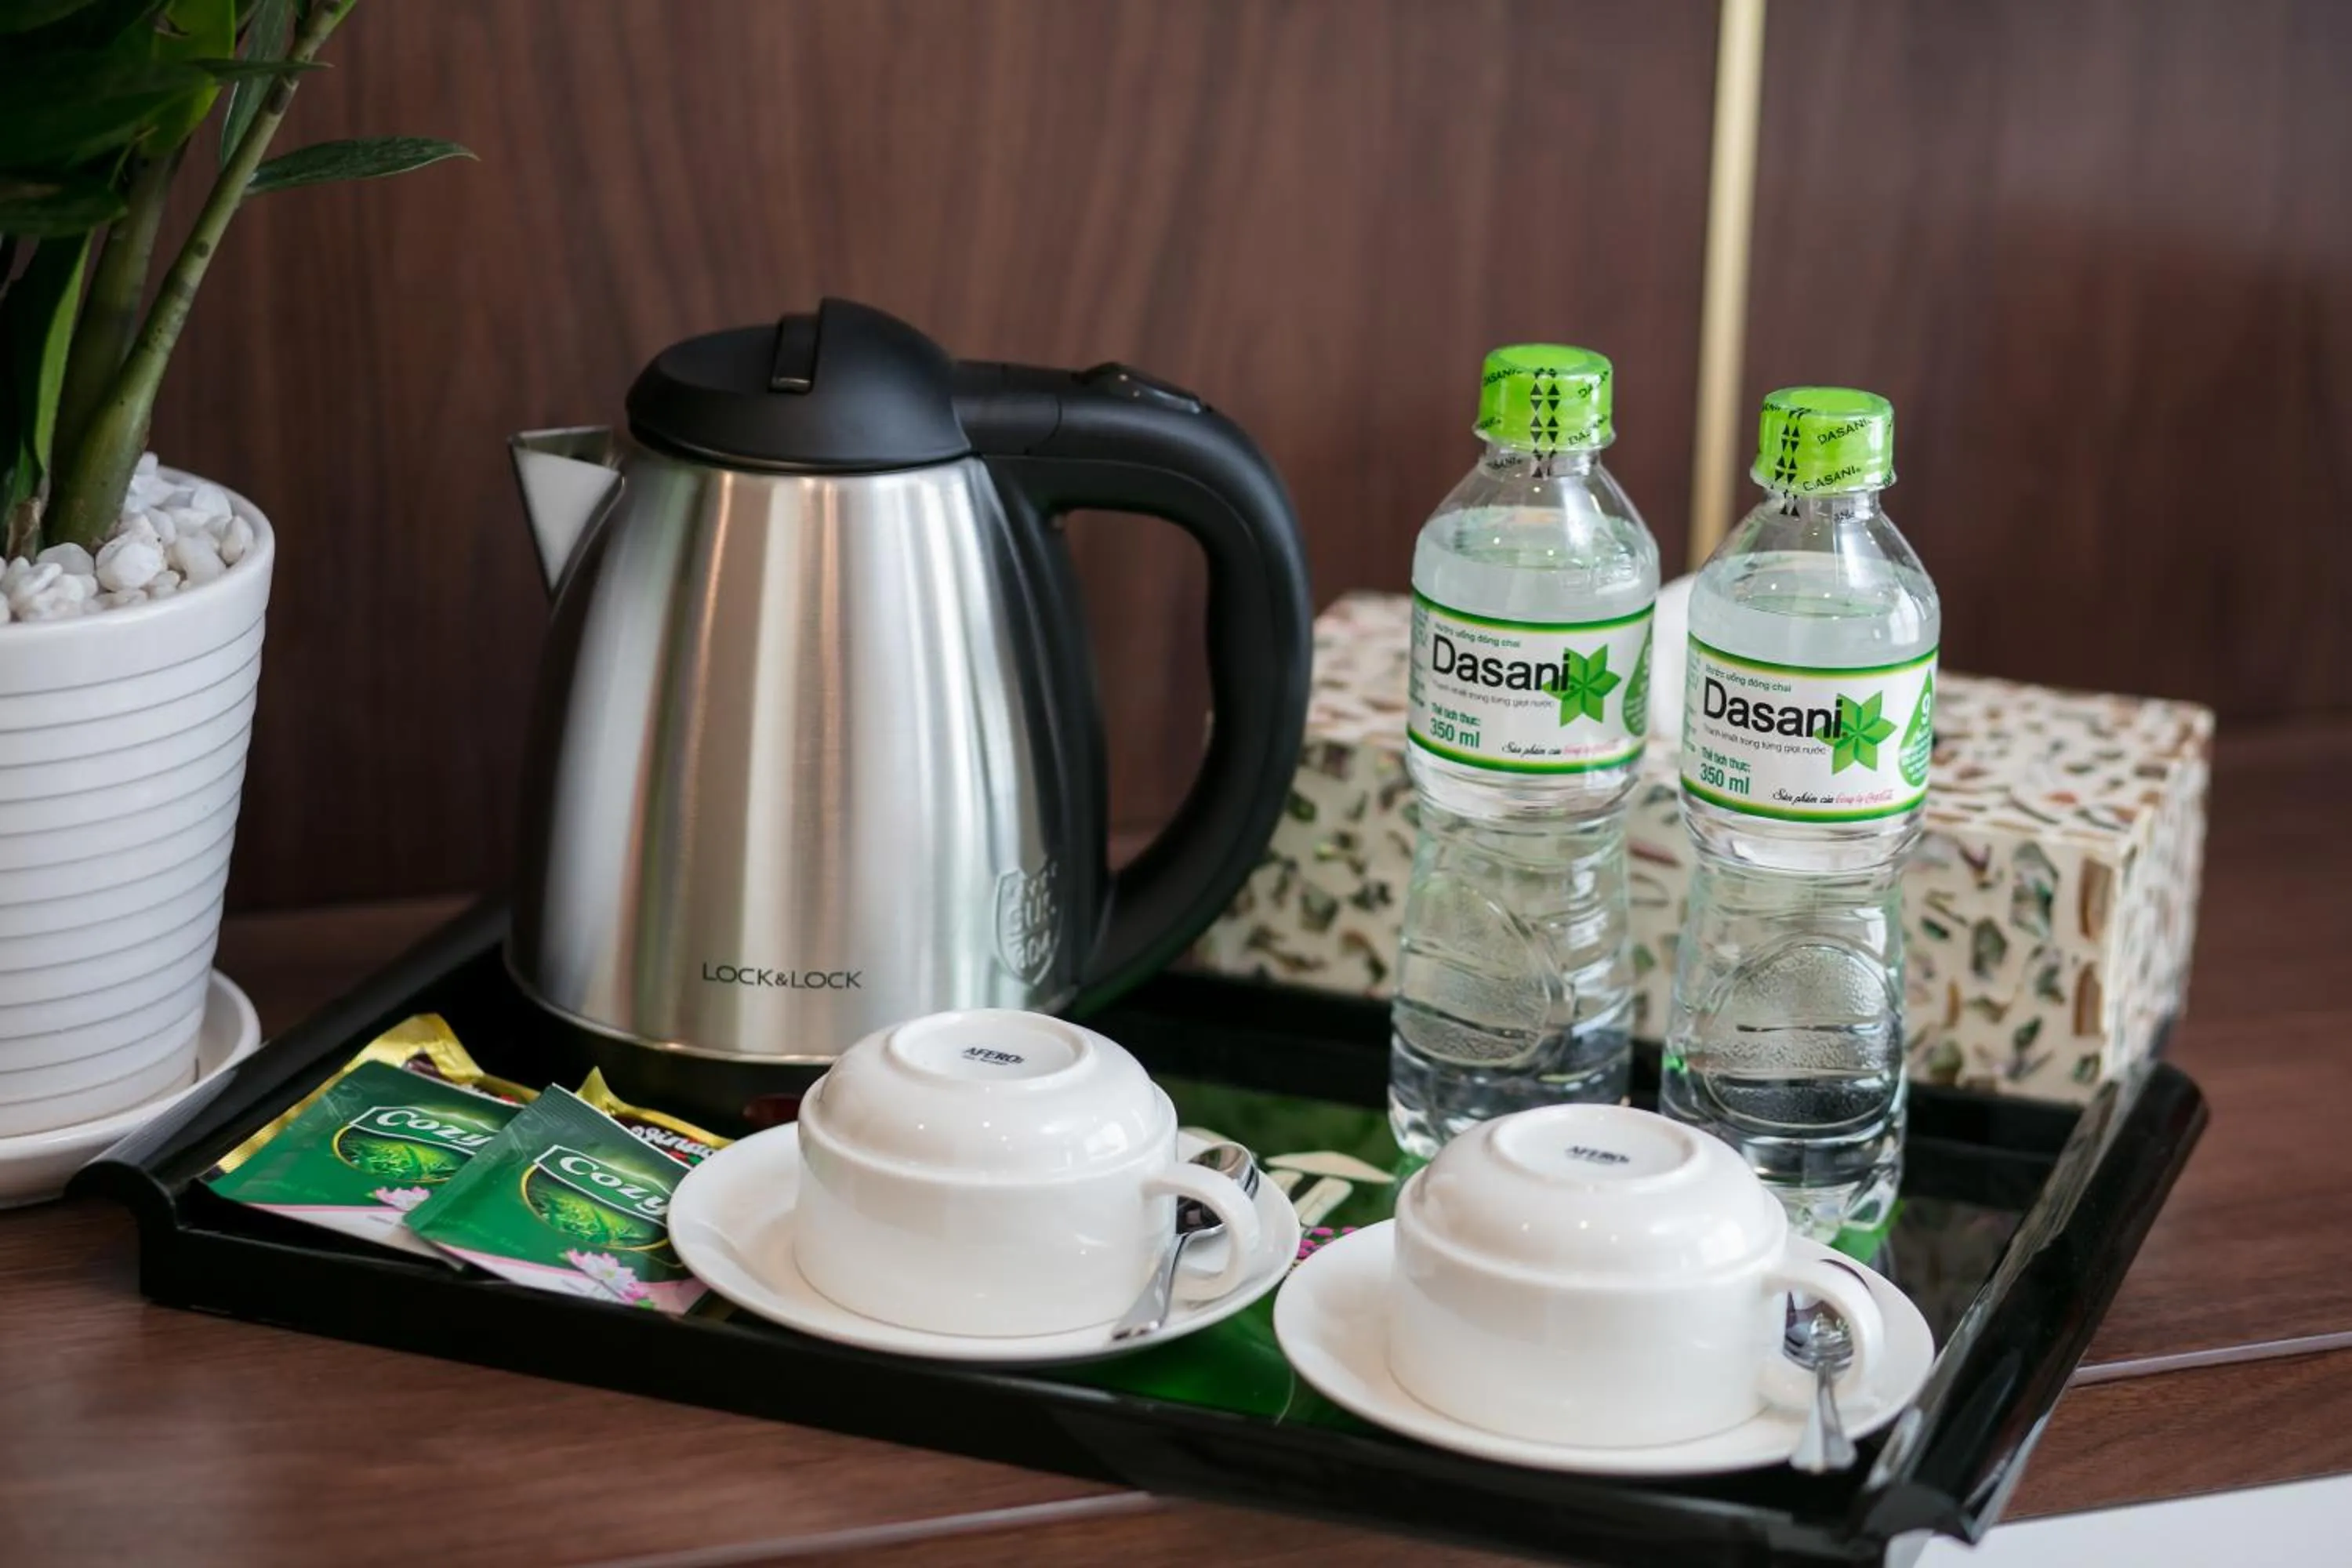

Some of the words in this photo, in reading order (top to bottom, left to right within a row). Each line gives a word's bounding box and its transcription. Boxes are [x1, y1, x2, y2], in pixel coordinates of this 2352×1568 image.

[1432, 633, 1570, 691] Dasani
[1704, 677, 1842, 739] Dasani
[1430, 717, 1456, 742] 350
[1460, 731, 1480, 749] ml
[1700, 763, 1725, 787] 350
[1729, 777, 1750, 794] ml
[702, 961, 862, 989] LOCK&LOCK
[376, 1110, 495, 1147] Cozy
[560, 1156, 670, 1215] Cozy
